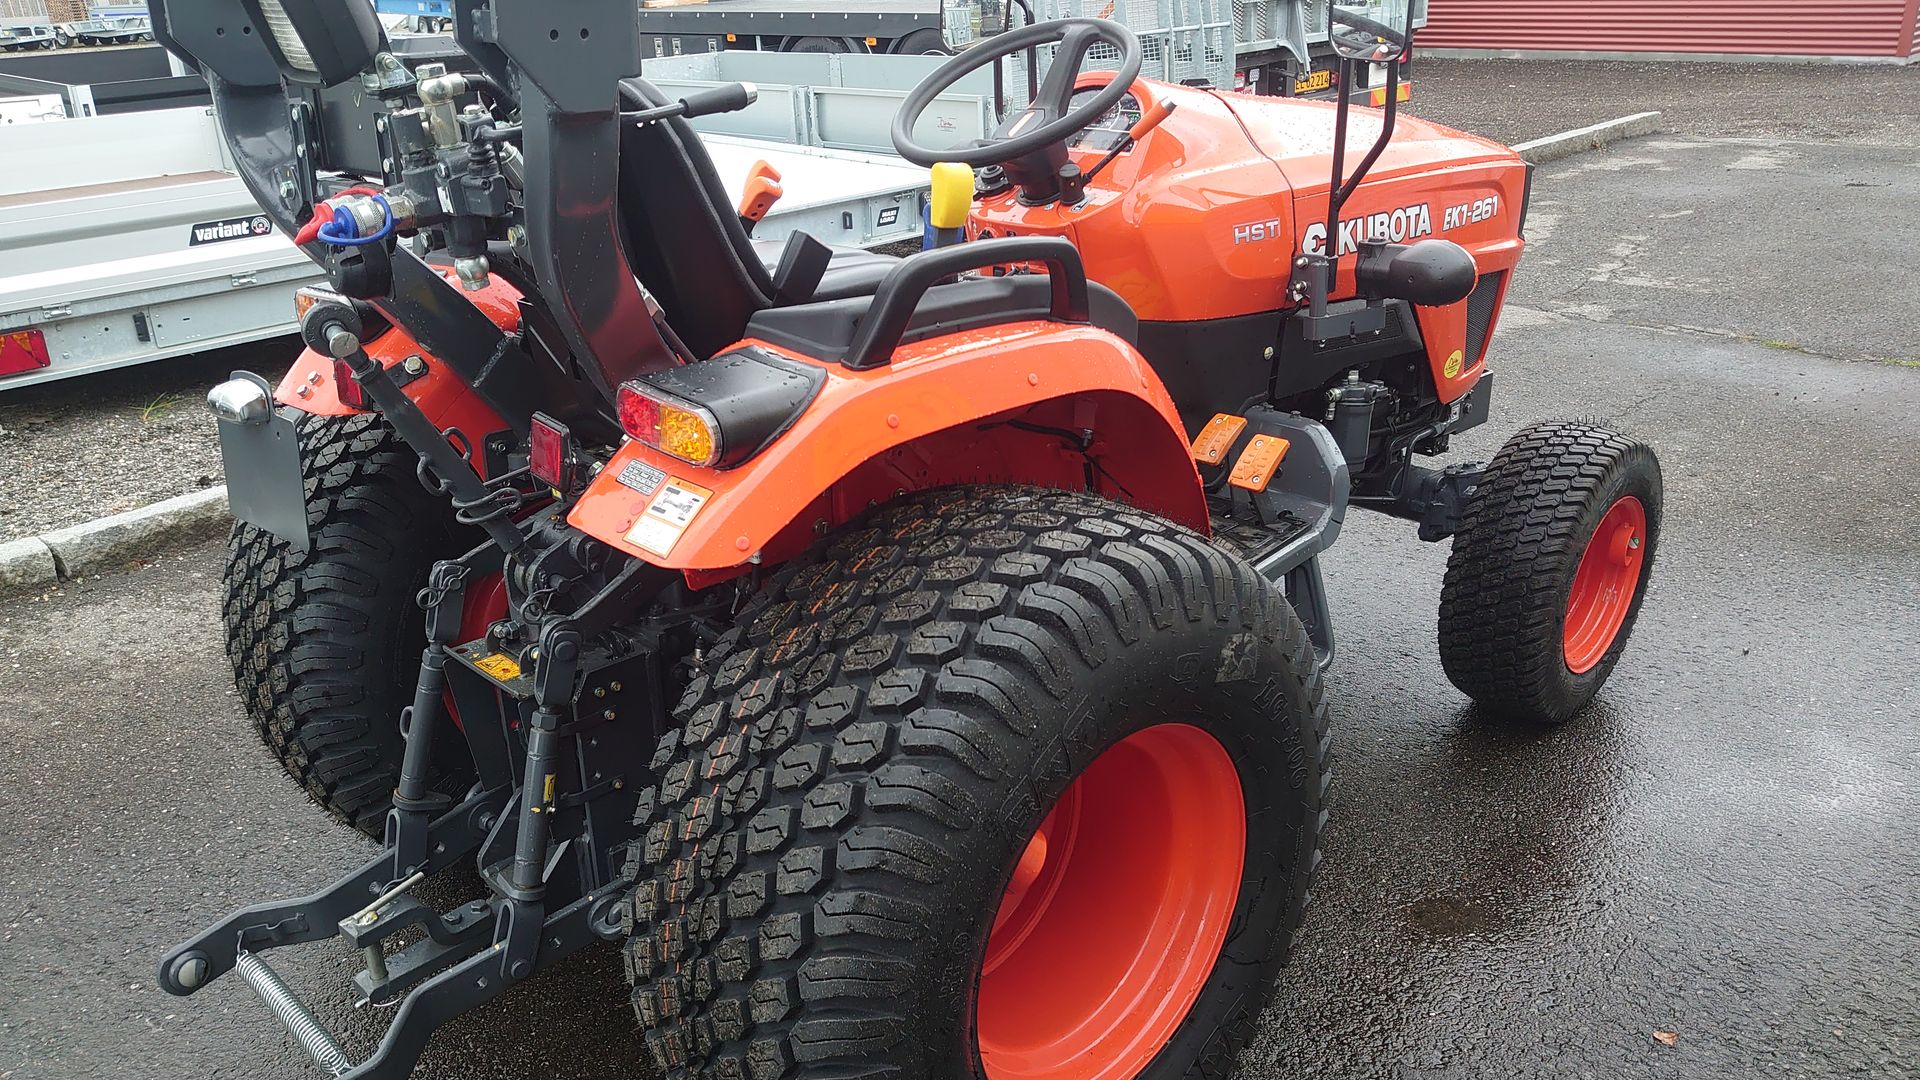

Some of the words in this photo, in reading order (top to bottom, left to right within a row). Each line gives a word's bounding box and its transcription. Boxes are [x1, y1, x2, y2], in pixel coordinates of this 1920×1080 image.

[1337, 202, 1433, 256] KUBOTA
[1442, 195, 1499, 232] EK1-261
[194, 220, 250, 242] variant
[1233, 219, 1281, 245] HST
